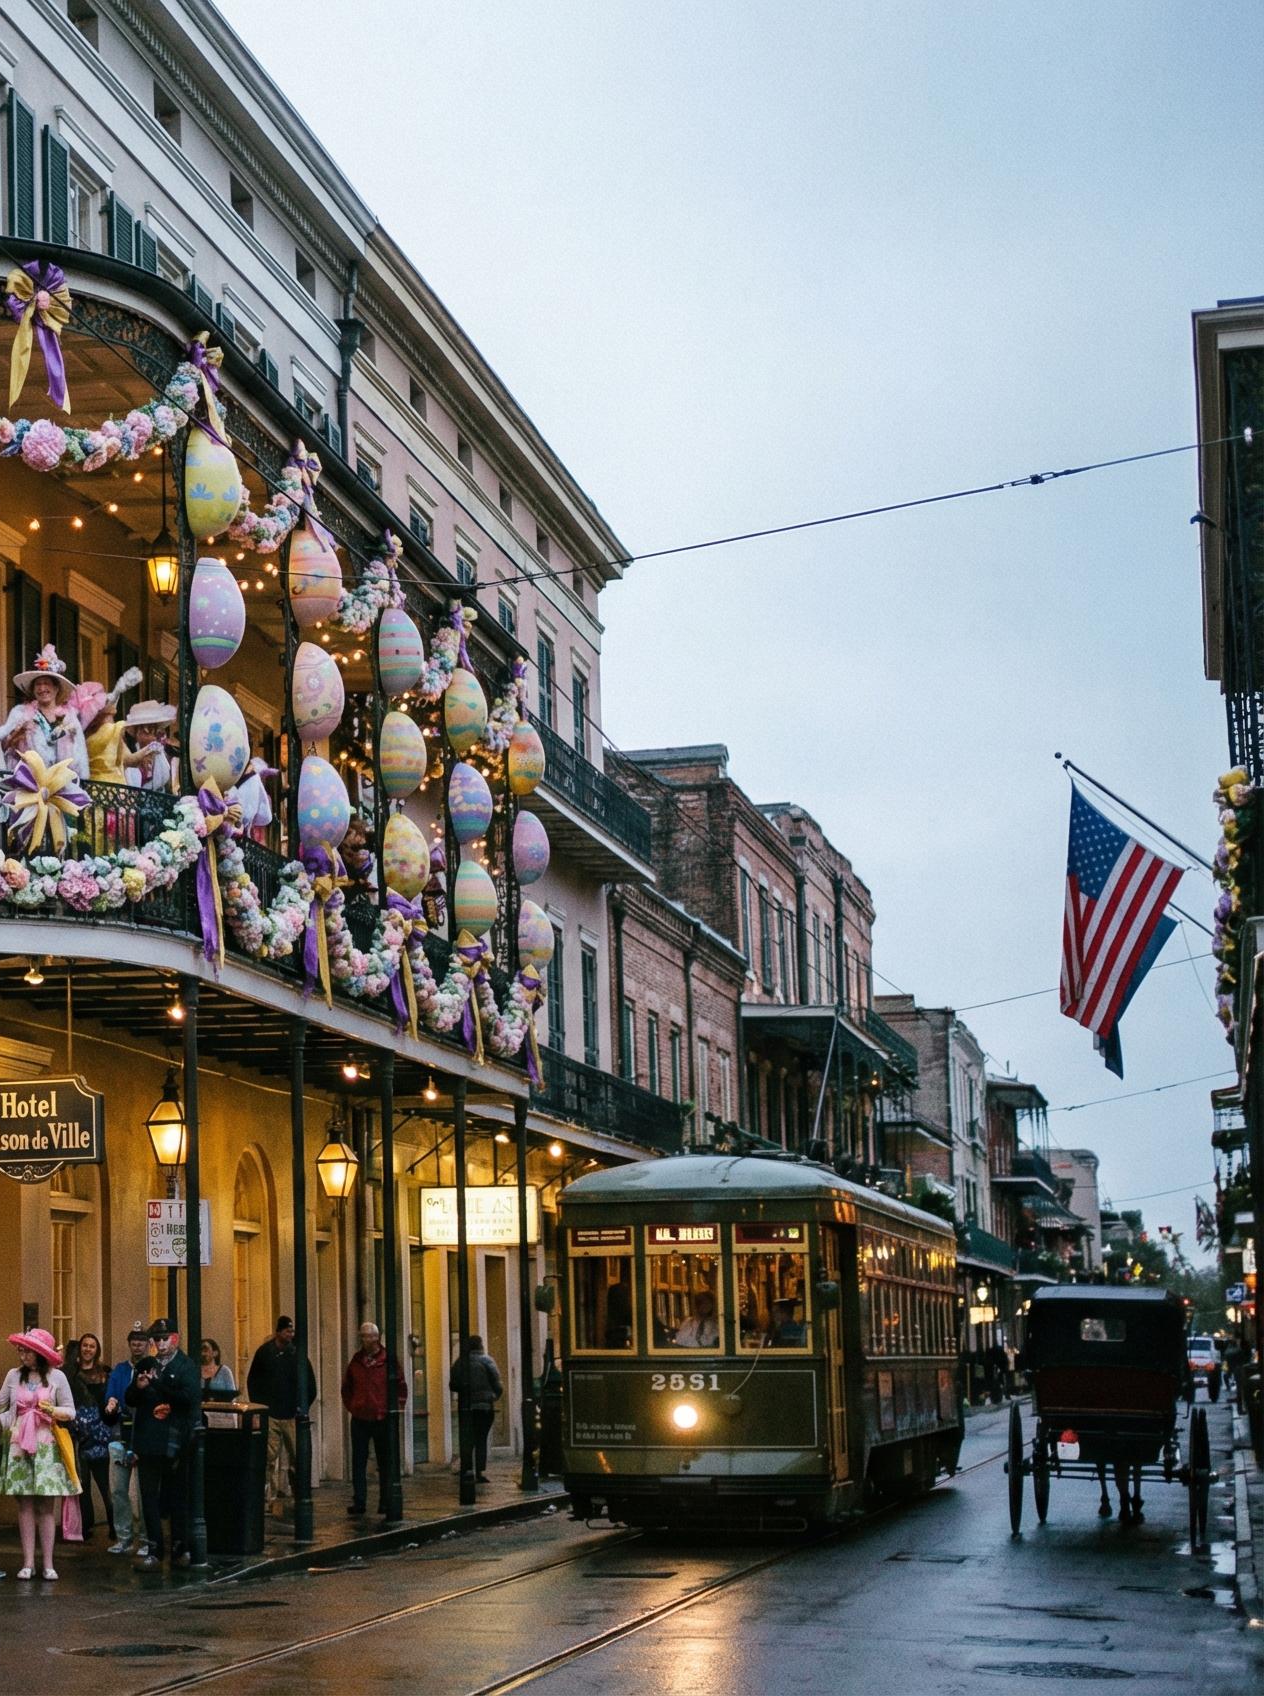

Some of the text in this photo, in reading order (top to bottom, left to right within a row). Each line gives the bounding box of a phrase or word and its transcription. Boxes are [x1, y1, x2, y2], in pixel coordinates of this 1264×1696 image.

[0, 1090, 58, 1119] Hotel
[31, 1130, 49, 1150] de
[48, 1122, 91, 1150] Ville
